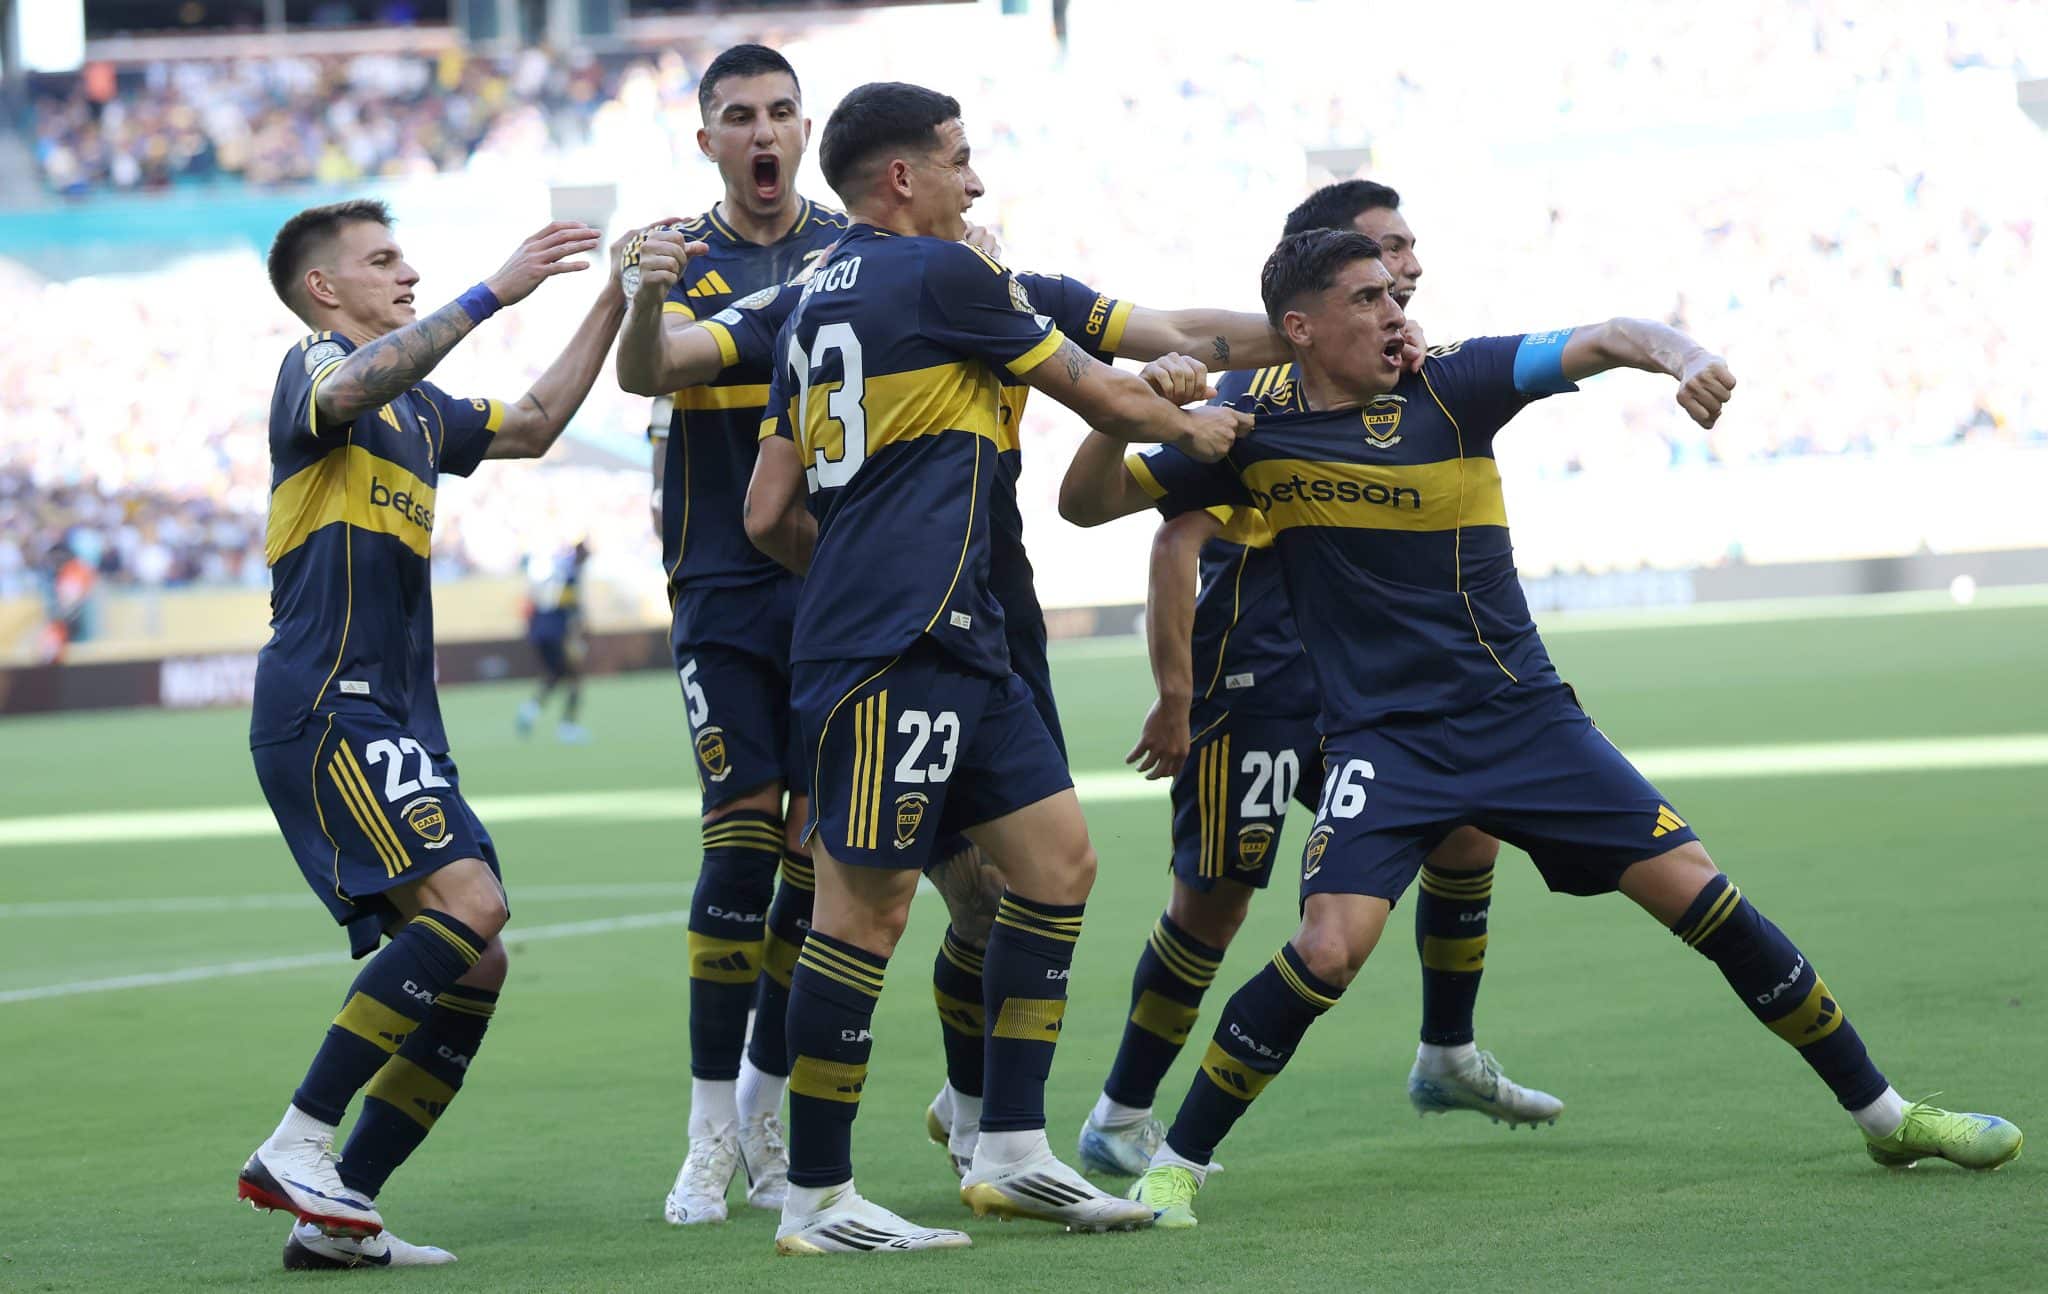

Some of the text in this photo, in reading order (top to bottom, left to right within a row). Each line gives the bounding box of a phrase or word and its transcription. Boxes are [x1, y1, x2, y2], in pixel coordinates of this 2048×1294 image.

[1368, 414, 1396, 423] CABJ
[370, 476, 435, 533] betss
[680, 658, 710, 729] 5
[365, 737, 451, 803] 22
[894, 710, 961, 783] 23
[1240, 749, 1300, 818] 20
[1315, 758, 1376, 828] 16
[417, 814, 440, 828] CABJ
[402, 980, 437, 1005] CA
[1229, 1023, 1283, 1059] CABJ
